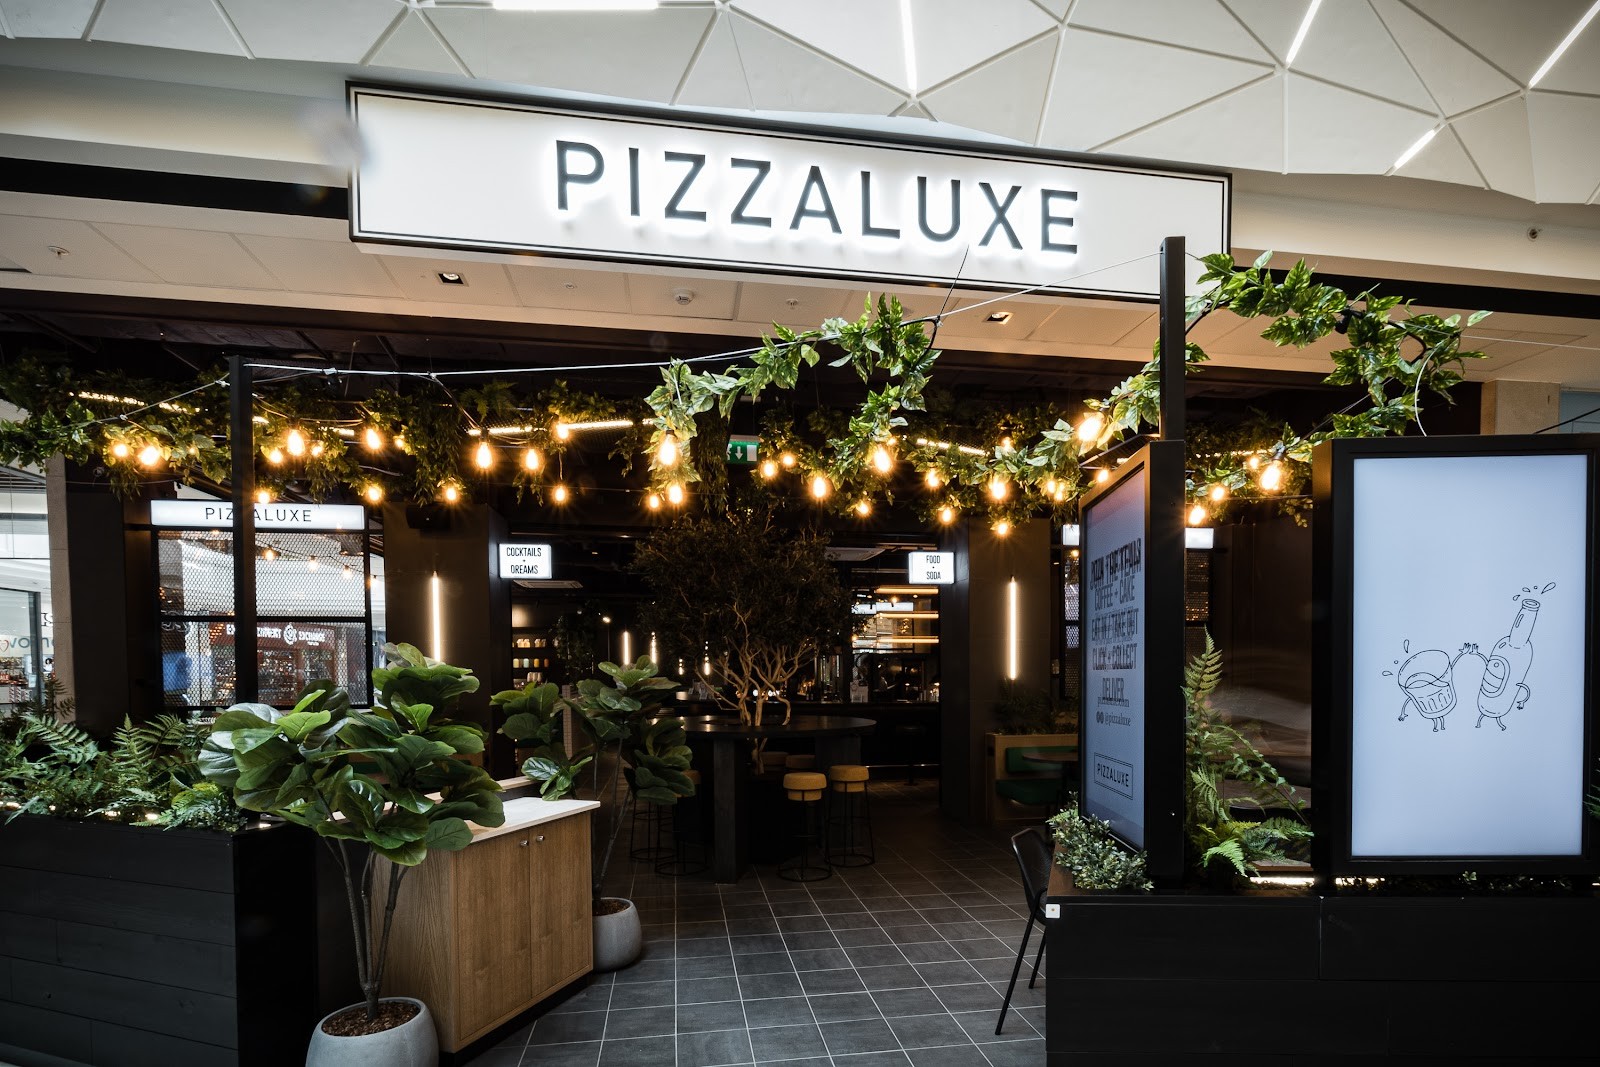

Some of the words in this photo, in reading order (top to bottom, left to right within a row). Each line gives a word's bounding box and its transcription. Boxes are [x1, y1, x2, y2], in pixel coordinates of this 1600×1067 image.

[555, 139, 1079, 255] PIZZALUXE
[205, 507, 312, 522] PIZALUXE
[506, 547, 541, 556] COCKTAILS
[926, 554, 940, 564] FOOD
[510, 564, 539, 574] DREAMS
[926, 571, 941, 580] SODA
[1095, 583, 1113, 611] COFFEE
[1119, 574, 1135, 604] CAKE
[1097, 763, 1129, 787] PIZZALUXE
